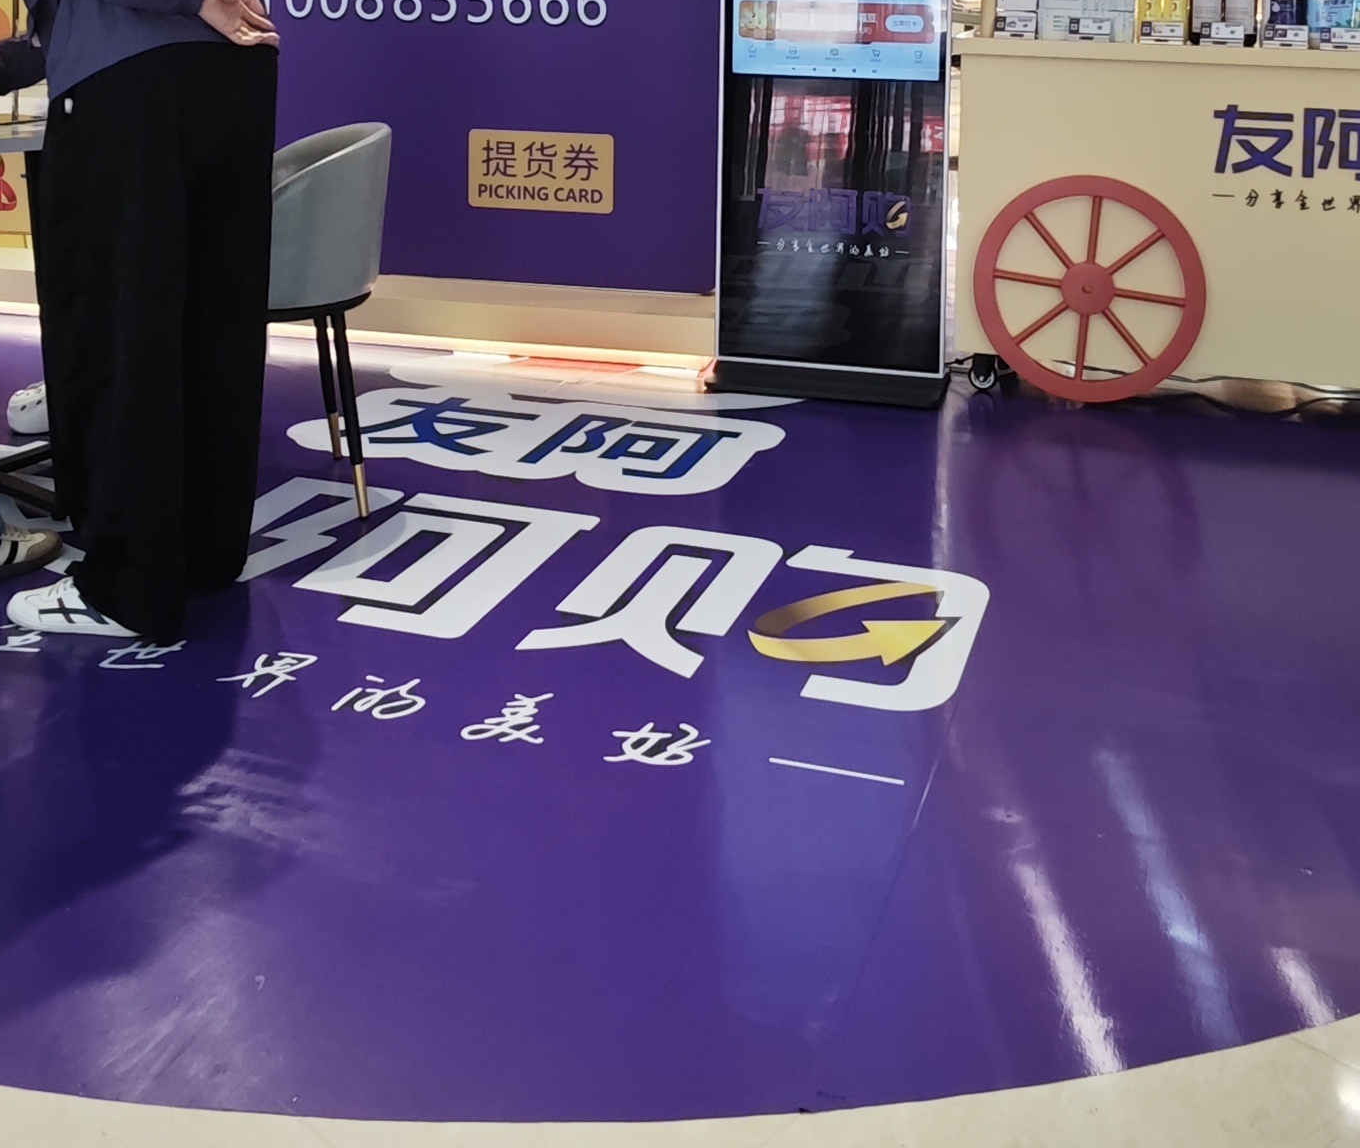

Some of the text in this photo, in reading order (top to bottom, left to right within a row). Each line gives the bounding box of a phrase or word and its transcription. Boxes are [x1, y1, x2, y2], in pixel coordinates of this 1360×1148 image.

[481, 139, 600, 182] 提货券
[477, 183, 604, 205] PICKING CARD
[757, 186, 911, 238] 友阿购
[342, 396, 743, 479] 友阿
